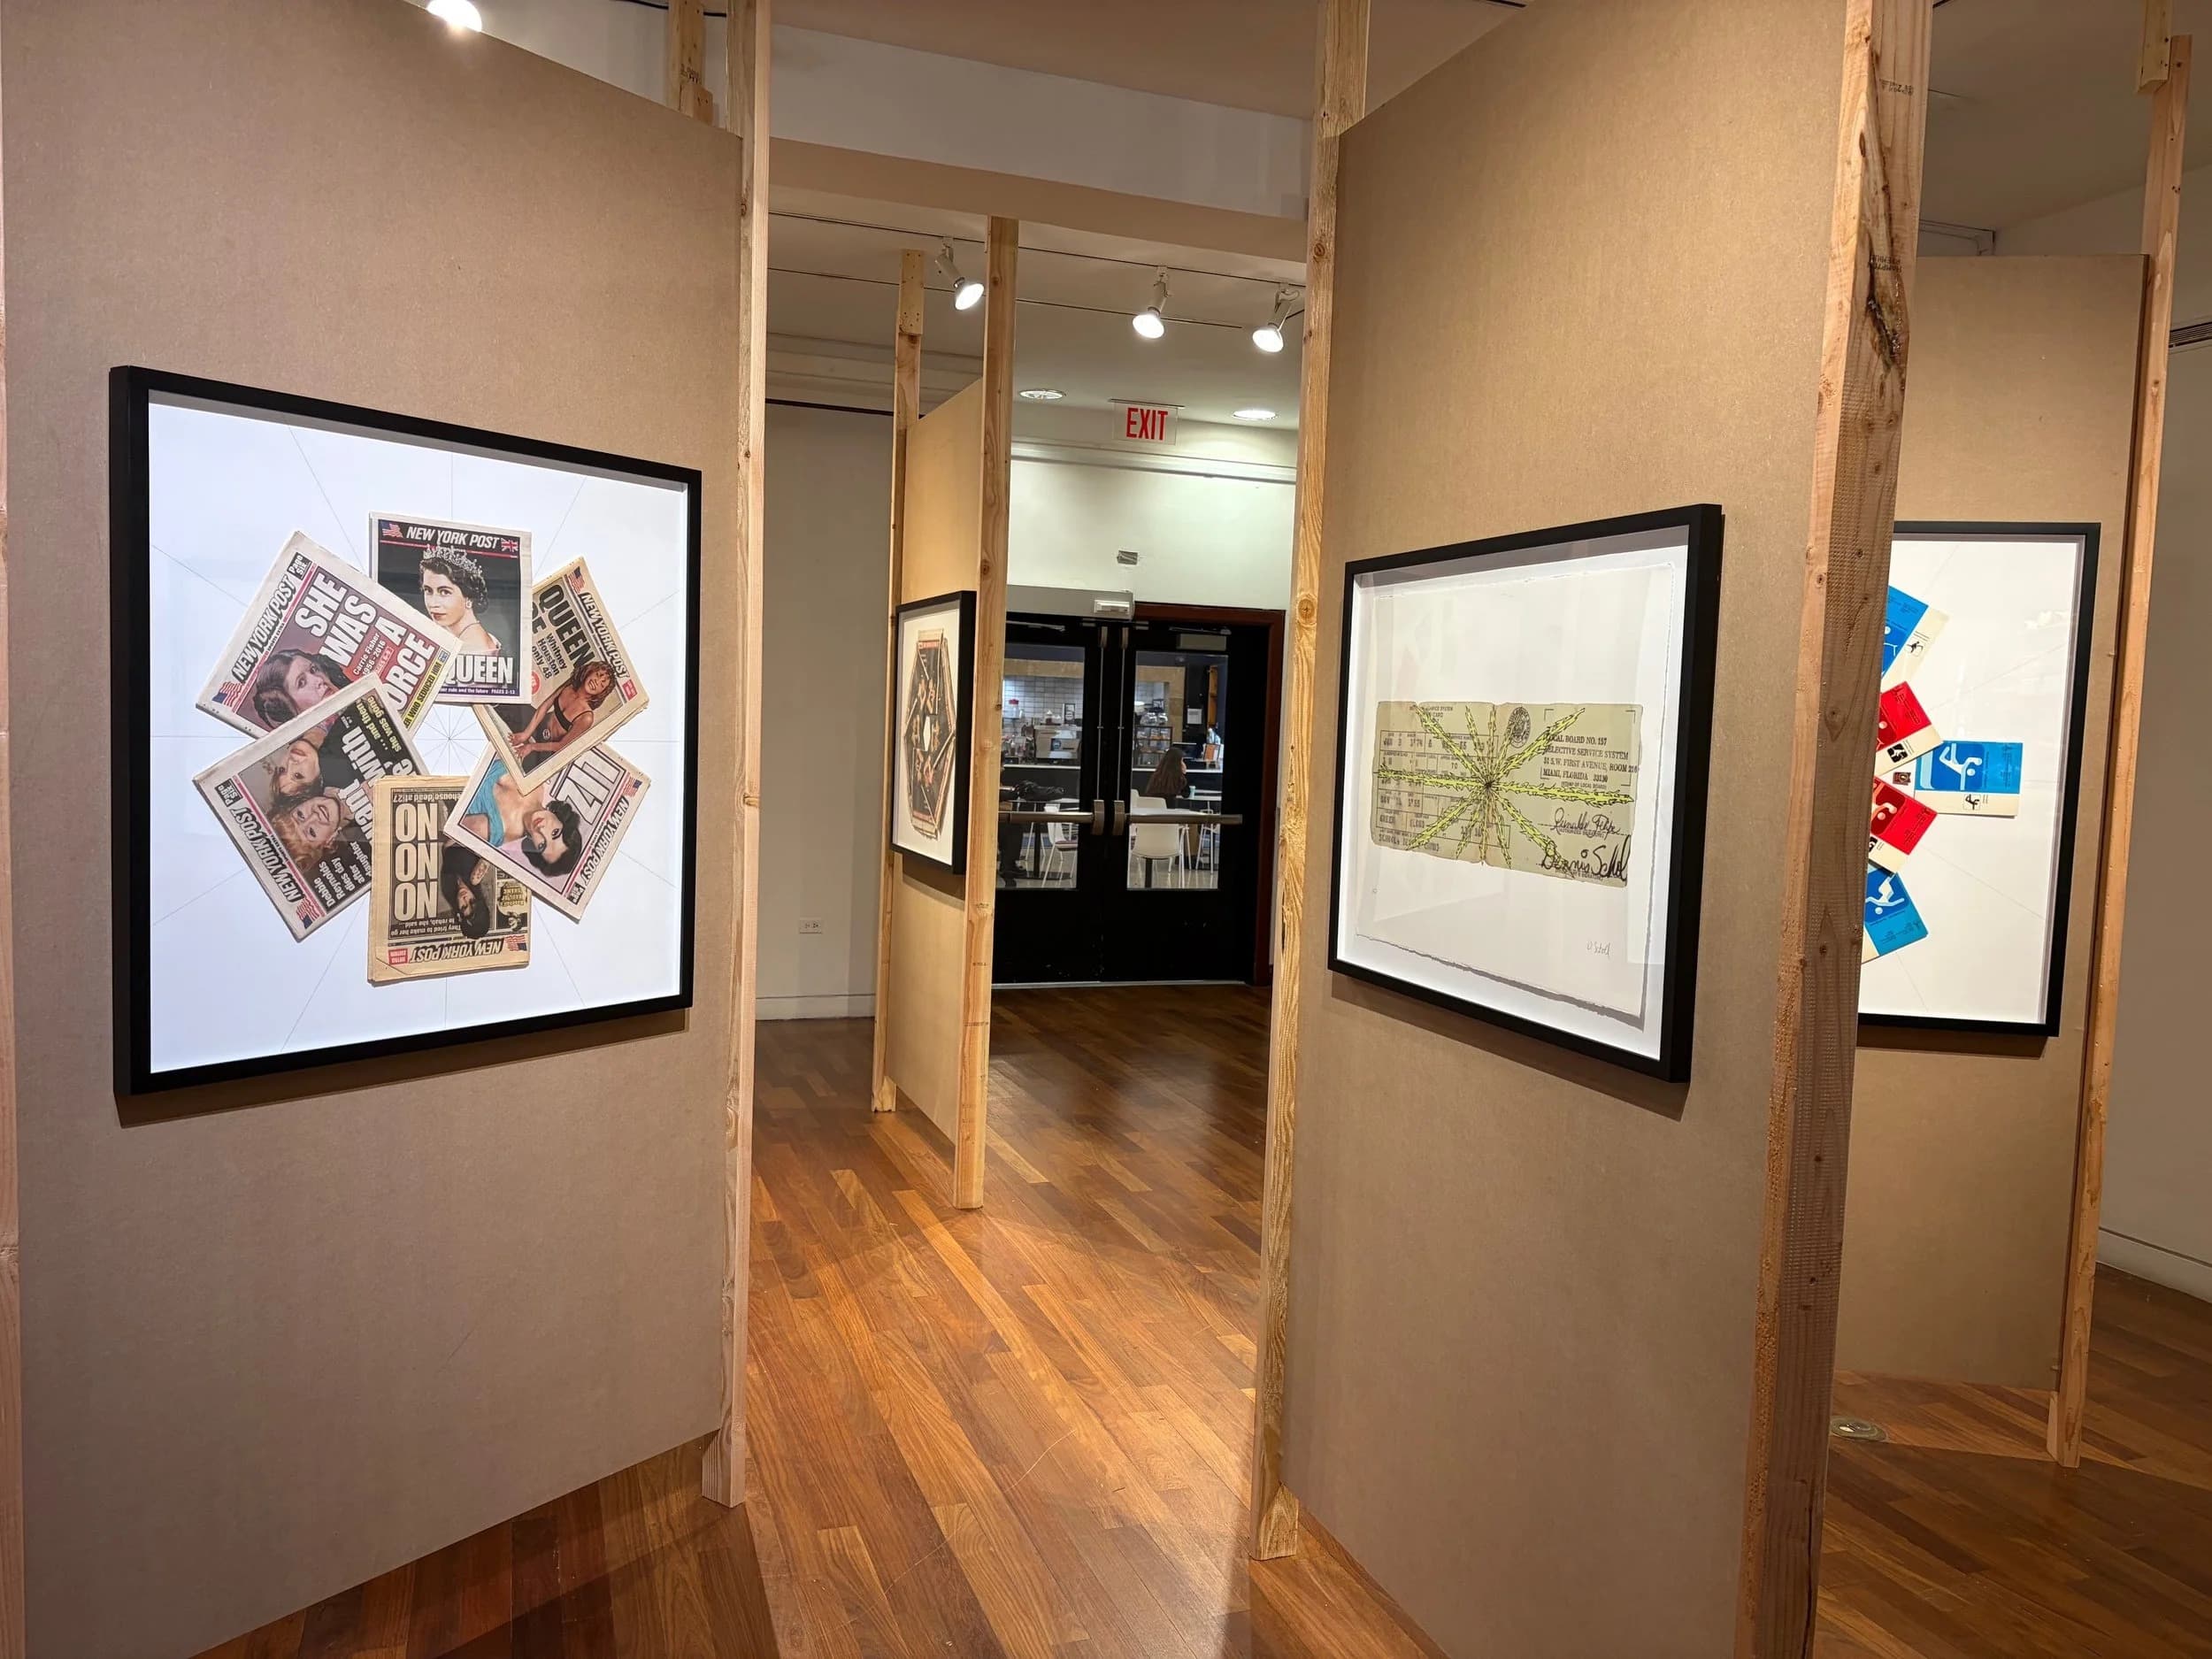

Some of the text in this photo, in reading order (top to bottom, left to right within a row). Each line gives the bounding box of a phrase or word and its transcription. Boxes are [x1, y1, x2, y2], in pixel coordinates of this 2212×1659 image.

[1125, 407, 1169, 441] EXIT
[407, 526, 500, 549] NEW YORK POST
[288, 554, 303, 573] Page
[296, 561, 307, 575] Six
[292, 572, 349, 638] SHE
[232, 573, 295, 680] NEW YORK POST
[319, 594, 379, 667] WAS
[374, 616, 408, 648] A
[538, 584, 595, 666] QUEEN
[579, 595, 600, 619] NEW
[591, 620, 616, 649] YORK
[606, 651, 630, 678] POST
[352, 632, 380, 675] Carrie Fisher
[529, 644, 546, 666] only
[541, 665, 552, 680] 48
[536, 638, 561, 675] Houston
[543, 633, 568, 670] Whitney
[380, 632, 436, 712] ORCE
[407, 701, 420, 718] WHO
[415, 673, 436, 702] SEDUCED
[430, 661, 442, 675] HIM
[355, 703, 372, 724] then
[365, 695, 403, 752] she was gone
[341, 726, 388, 787] with
[1577, 749, 1603, 757] SERVICE
[1604, 751, 1629, 760] SYSTEM
[1597, 737, 1607, 746] 157
[1542, 768, 1562, 779] MIAMI,
[1563, 771, 1588, 780] FLORIDA
[1563, 758, 1580, 768] FIRST
[1581, 760, 1608, 772] AVENUE,
[216, 784, 234, 805] Page
[413, 793, 433, 802] dead
[434, 792, 461, 801] ehouse
[557, 748, 624, 825] LIZ
[394, 802, 438, 841] NO
[609, 798, 629, 826] NEW
[230, 806, 302, 900] NEW YORK POST
[593, 822, 617, 856] YORK
[317, 859, 346, 899] Reynolds
[329, 856, 356, 892] dies day
[348, 863, 365, 885] after
[392, 841, 437, 881] NO
[577, 851, 601, 886] POST
[312, 876, 335, 907] Debbie
[393, 880, 438, 920] NO
[409, 938, 501, 963] NEW YORK POST
